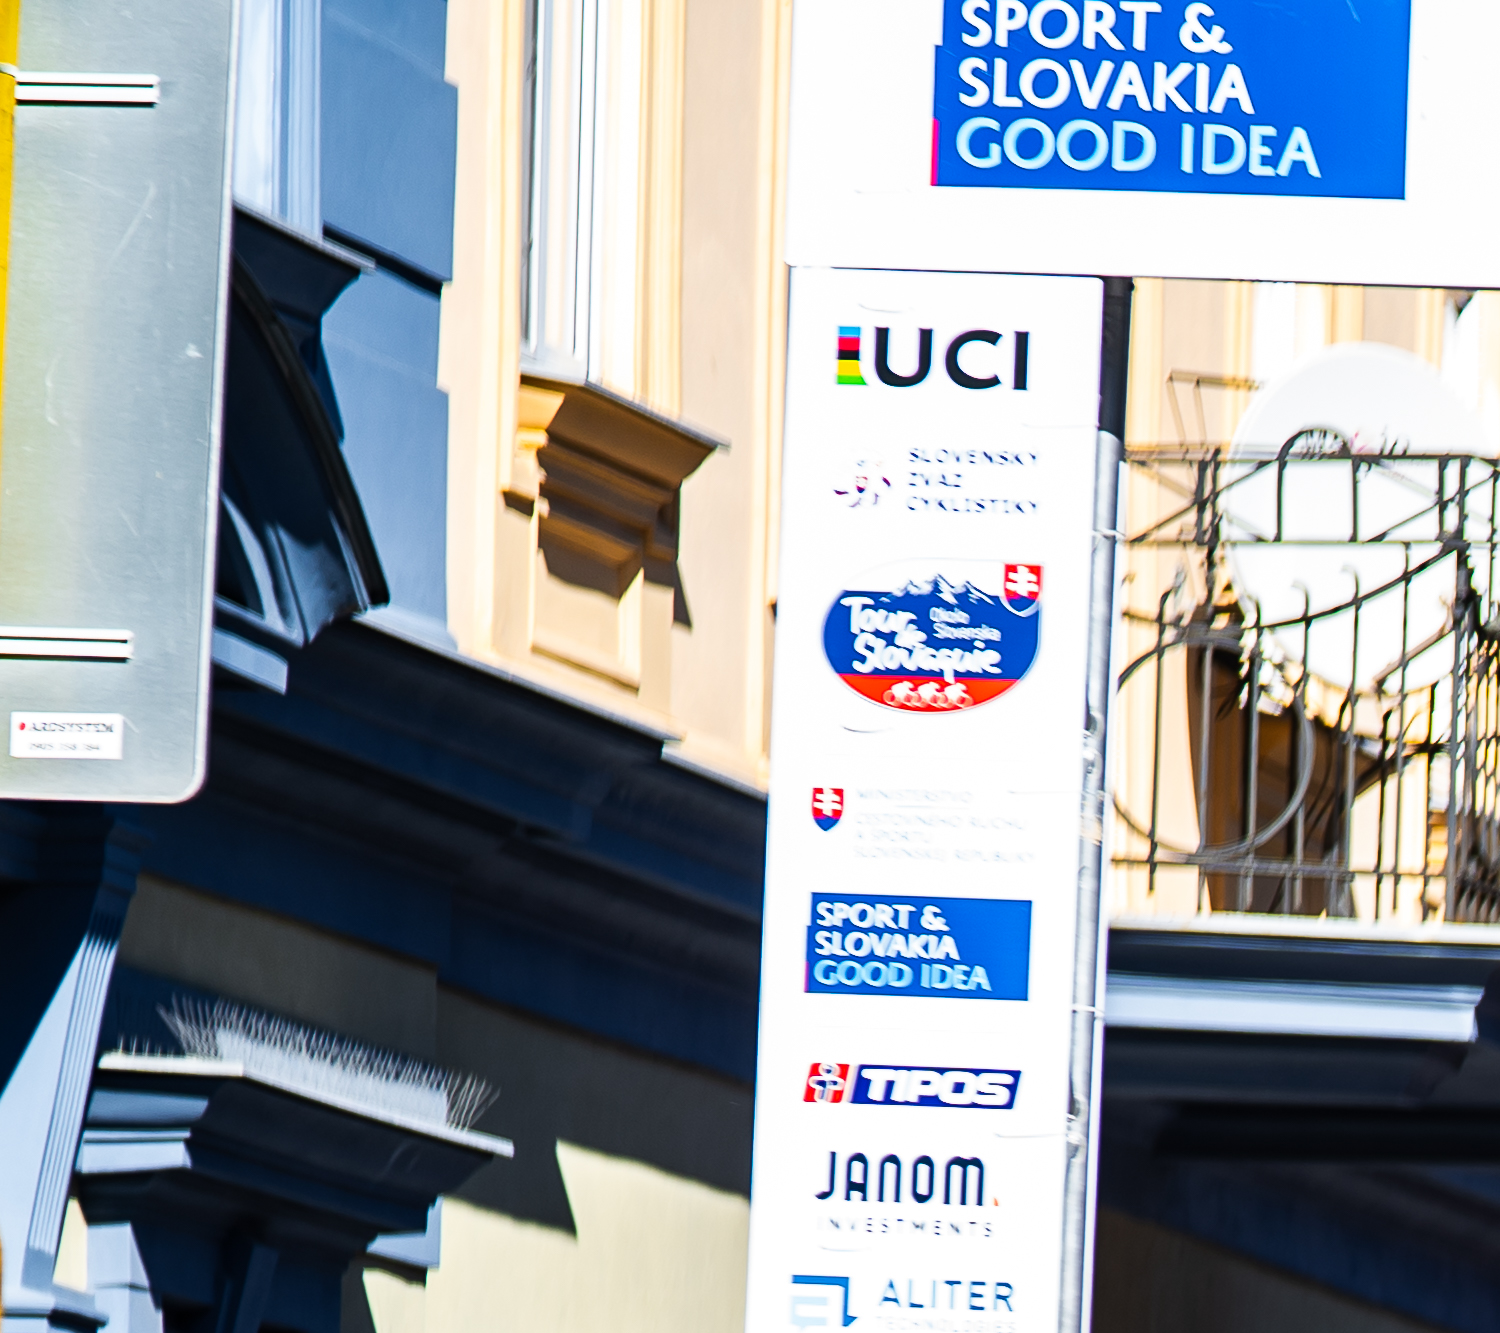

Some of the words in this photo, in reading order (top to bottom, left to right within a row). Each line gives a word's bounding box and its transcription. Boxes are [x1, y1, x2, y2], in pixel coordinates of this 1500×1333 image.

[961, 0, 1161, 52] SPORT
[1179, 2, 1233, 54] &
[958, 57, 1256, 115] SLOVAKIA
[955, 116, 1157, 172] GOOD
[1180, 123, 1322, 178] IDEA
[875, 326, 1030, 391] UCI
[840, 596, 918, 635] Tour
[852, 632, 1002, 685] Slovaquie
[816, 901, 915, 931] SPORT
[919, 905, 950, 932] &
[814, 931, 960, 961] SLOVAKIA
[813, 960, 913, 988] GOOD
[920, 963, 992, 992] IDEA
[860, 1069, 1014, 1106] TIPOS
[817, 1217, 993, 1238] INVESTMENTS
[880, 1279, 1013, 1312] ALITER
